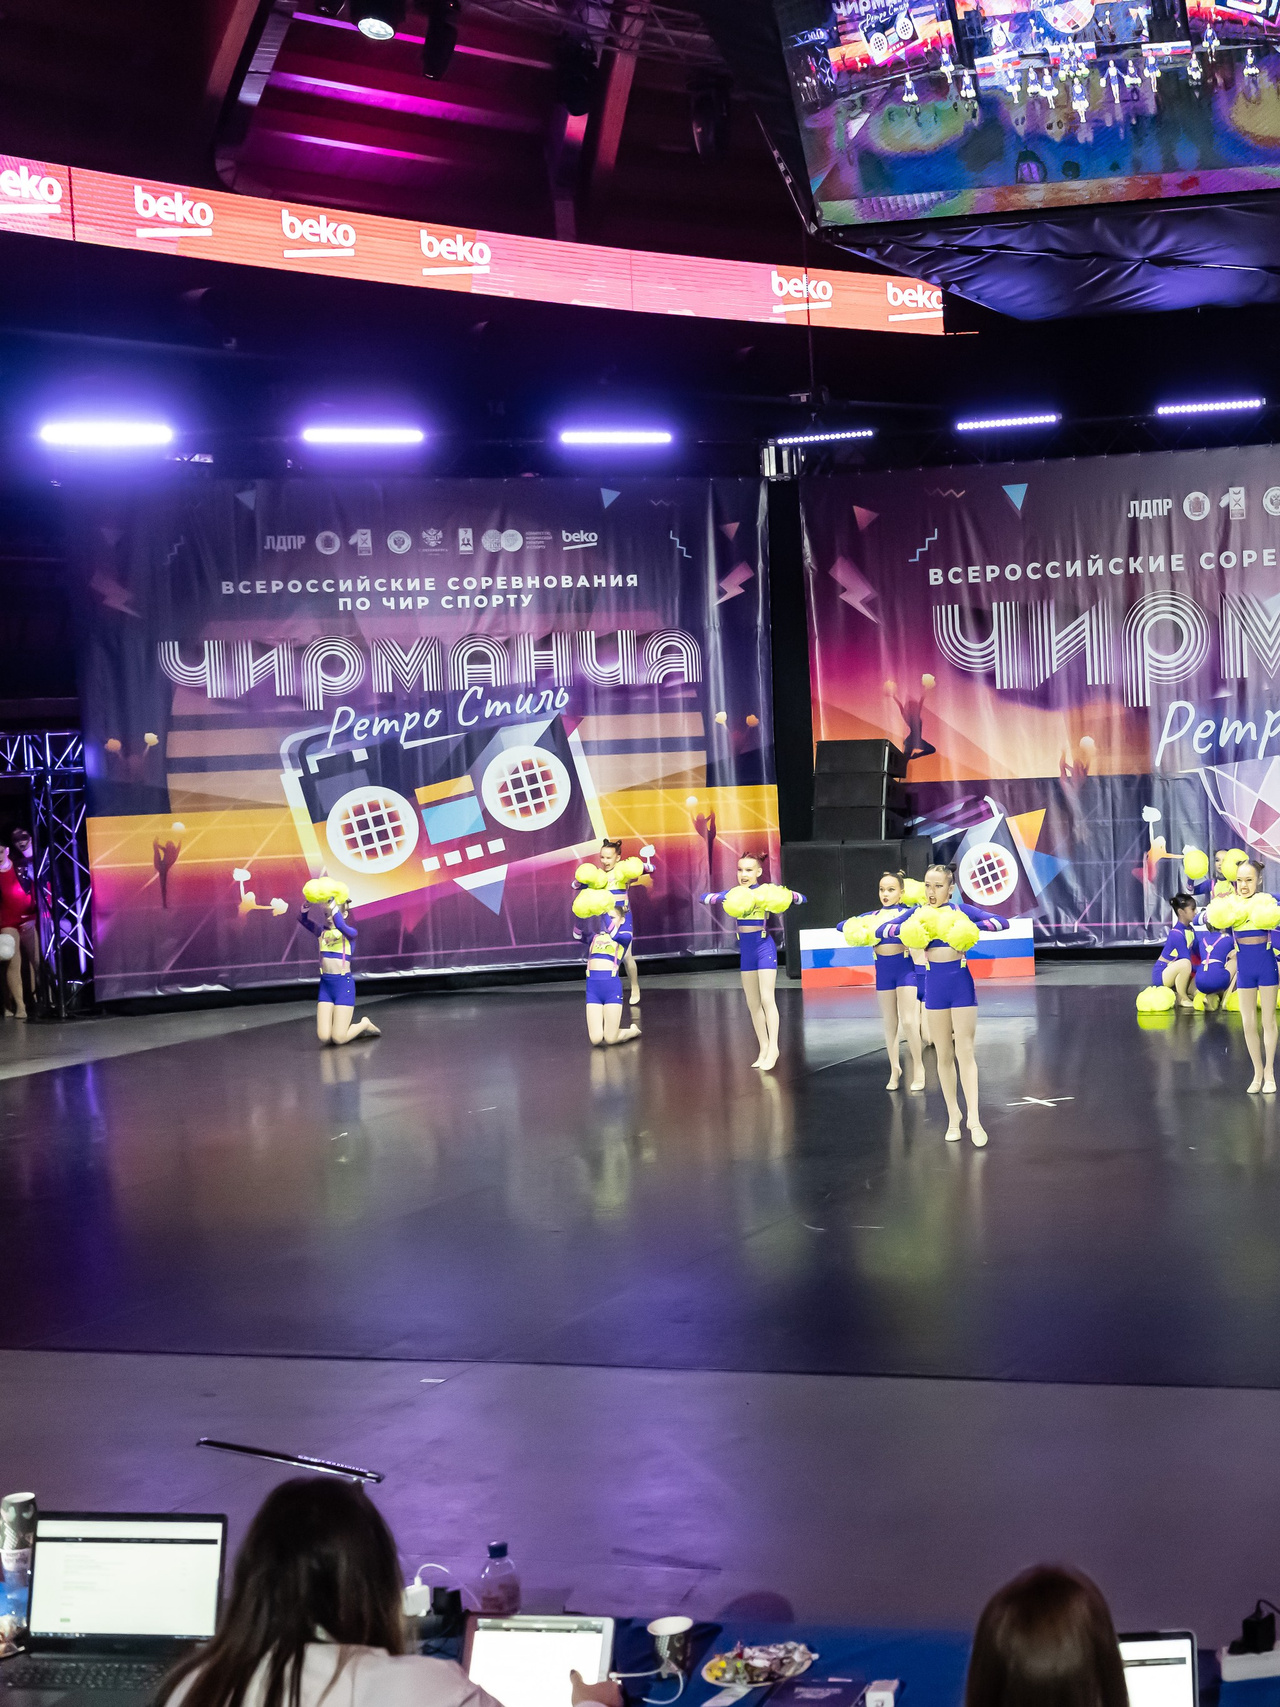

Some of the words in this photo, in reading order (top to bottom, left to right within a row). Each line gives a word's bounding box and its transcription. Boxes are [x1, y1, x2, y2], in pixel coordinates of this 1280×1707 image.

[0, 165, 62, 203] eko
[134, 186, 214, 226] beko
[281, 209, 356, 247] beko
[420, 230, 491, 265] beko
[771, 271, 833, 300] beko
[1128, 498, 1173, 520] ЛДПР
[264, 535, 307, 552] ЛДПР
[562, 529, 599, 543] beko
[221, 575, 437, 596] ВСЕРОССИЙСКИЕ
[447, 573, 640, 591] СОРЕВНОВАНИЯ
[928, 554, 1185, 586] ВСЕРОССИЙСКИЕ
[338, 597, 372, 612] ПО
[382, 595, 431, 611] ЧИР
[440, 593, 534, 610] СПОРТУ
[326, 705, 443, 750] Ретро
[457, 685, 570, 728] Стиль
